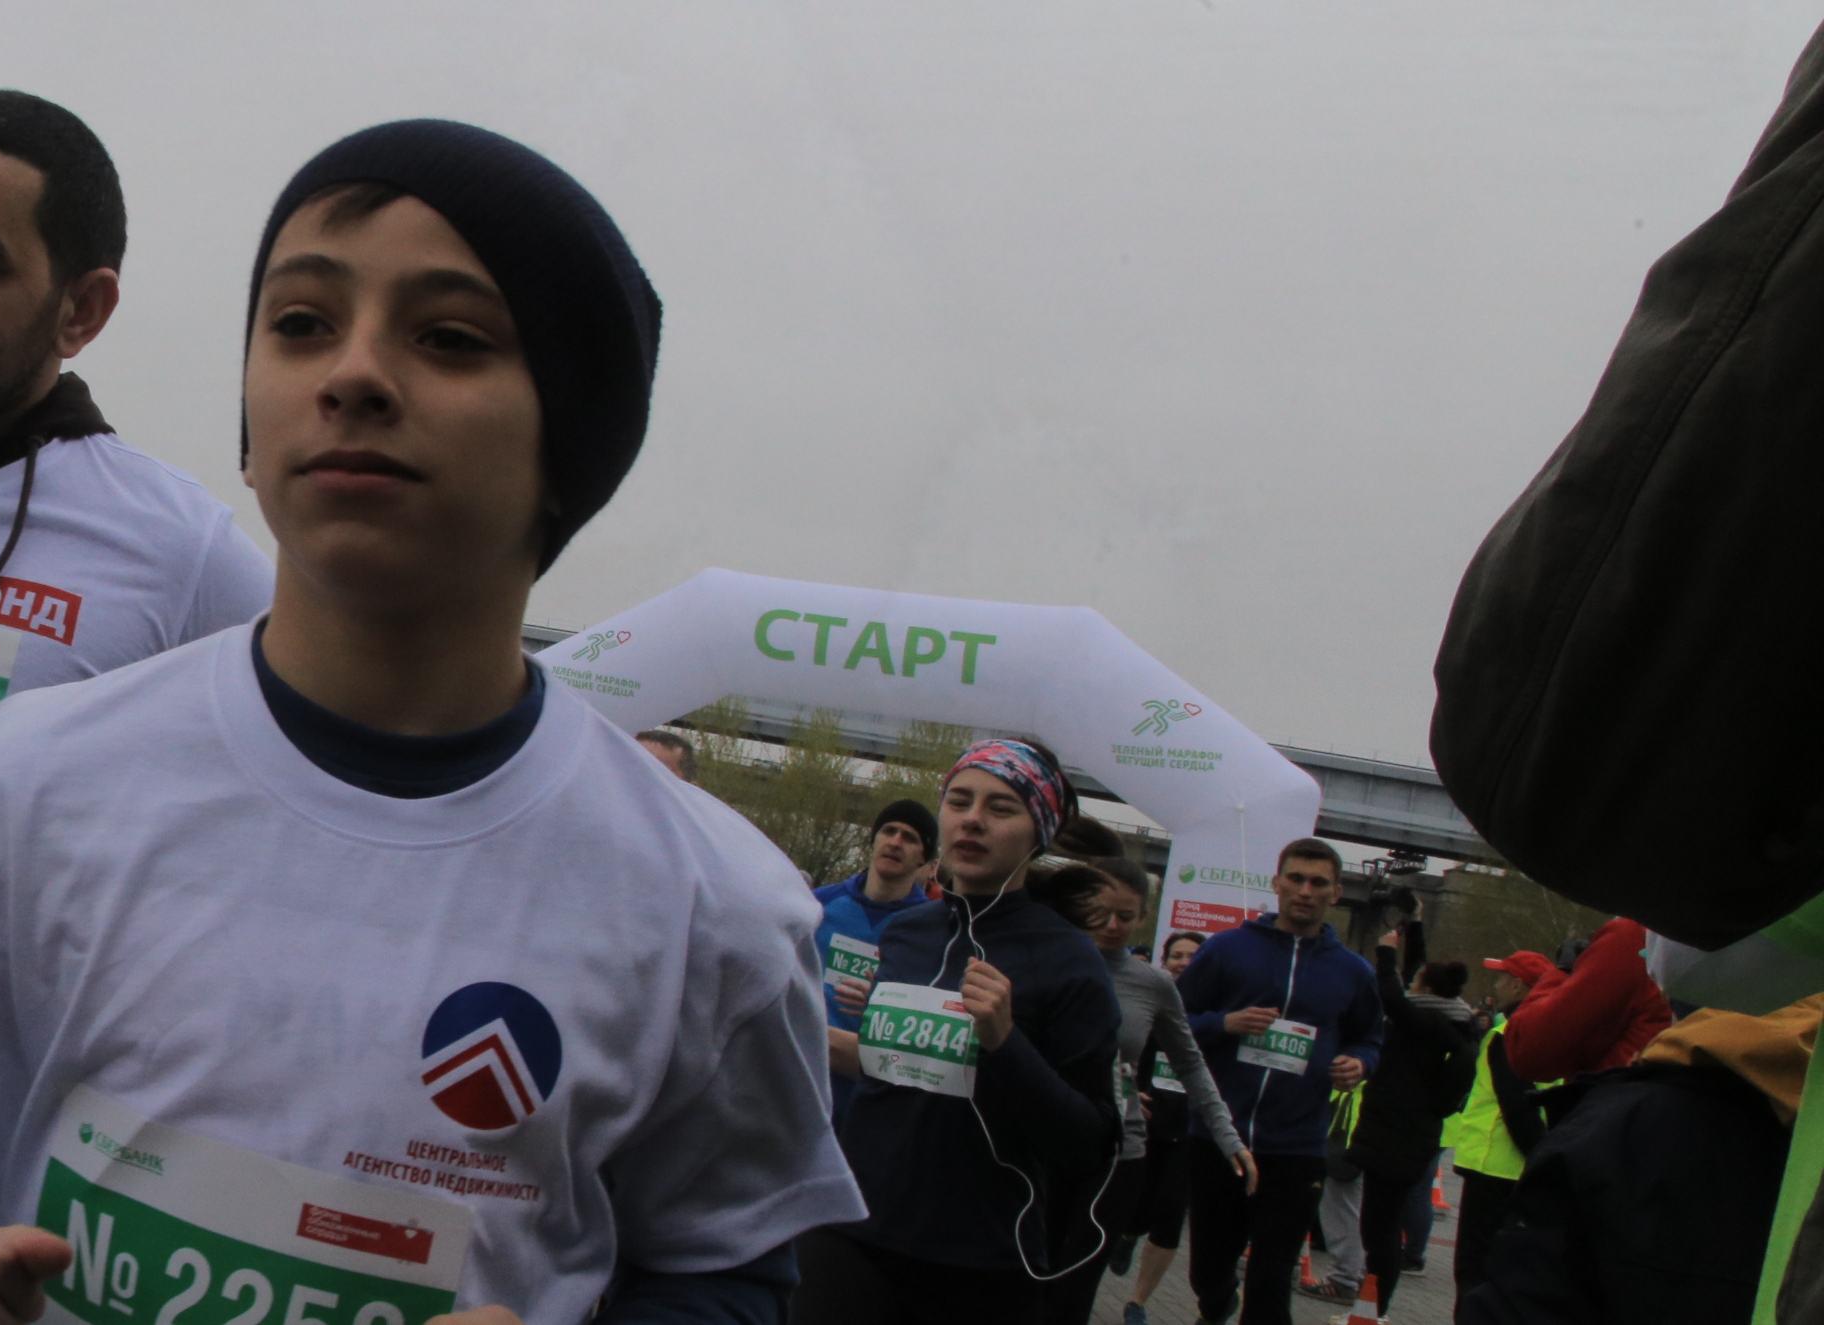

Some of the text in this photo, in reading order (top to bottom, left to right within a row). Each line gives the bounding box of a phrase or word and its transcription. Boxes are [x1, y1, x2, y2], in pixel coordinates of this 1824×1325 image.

[754, 609, 996, 685] СТАРТ
[1199, 866, 1272, 888] СБЕРБАН
[850, 957, 879, 976] 221
[897, 1015, 969, 1057] 2844
[1270, 1033, 1307, 1056] 1406
[407, 1140, 507, 1172] ЦЕНТРАЛЬНОЕ
[344, 1151, 540, 1201] АГЕНТСТВО НЕДВИЖИМОСТИ
